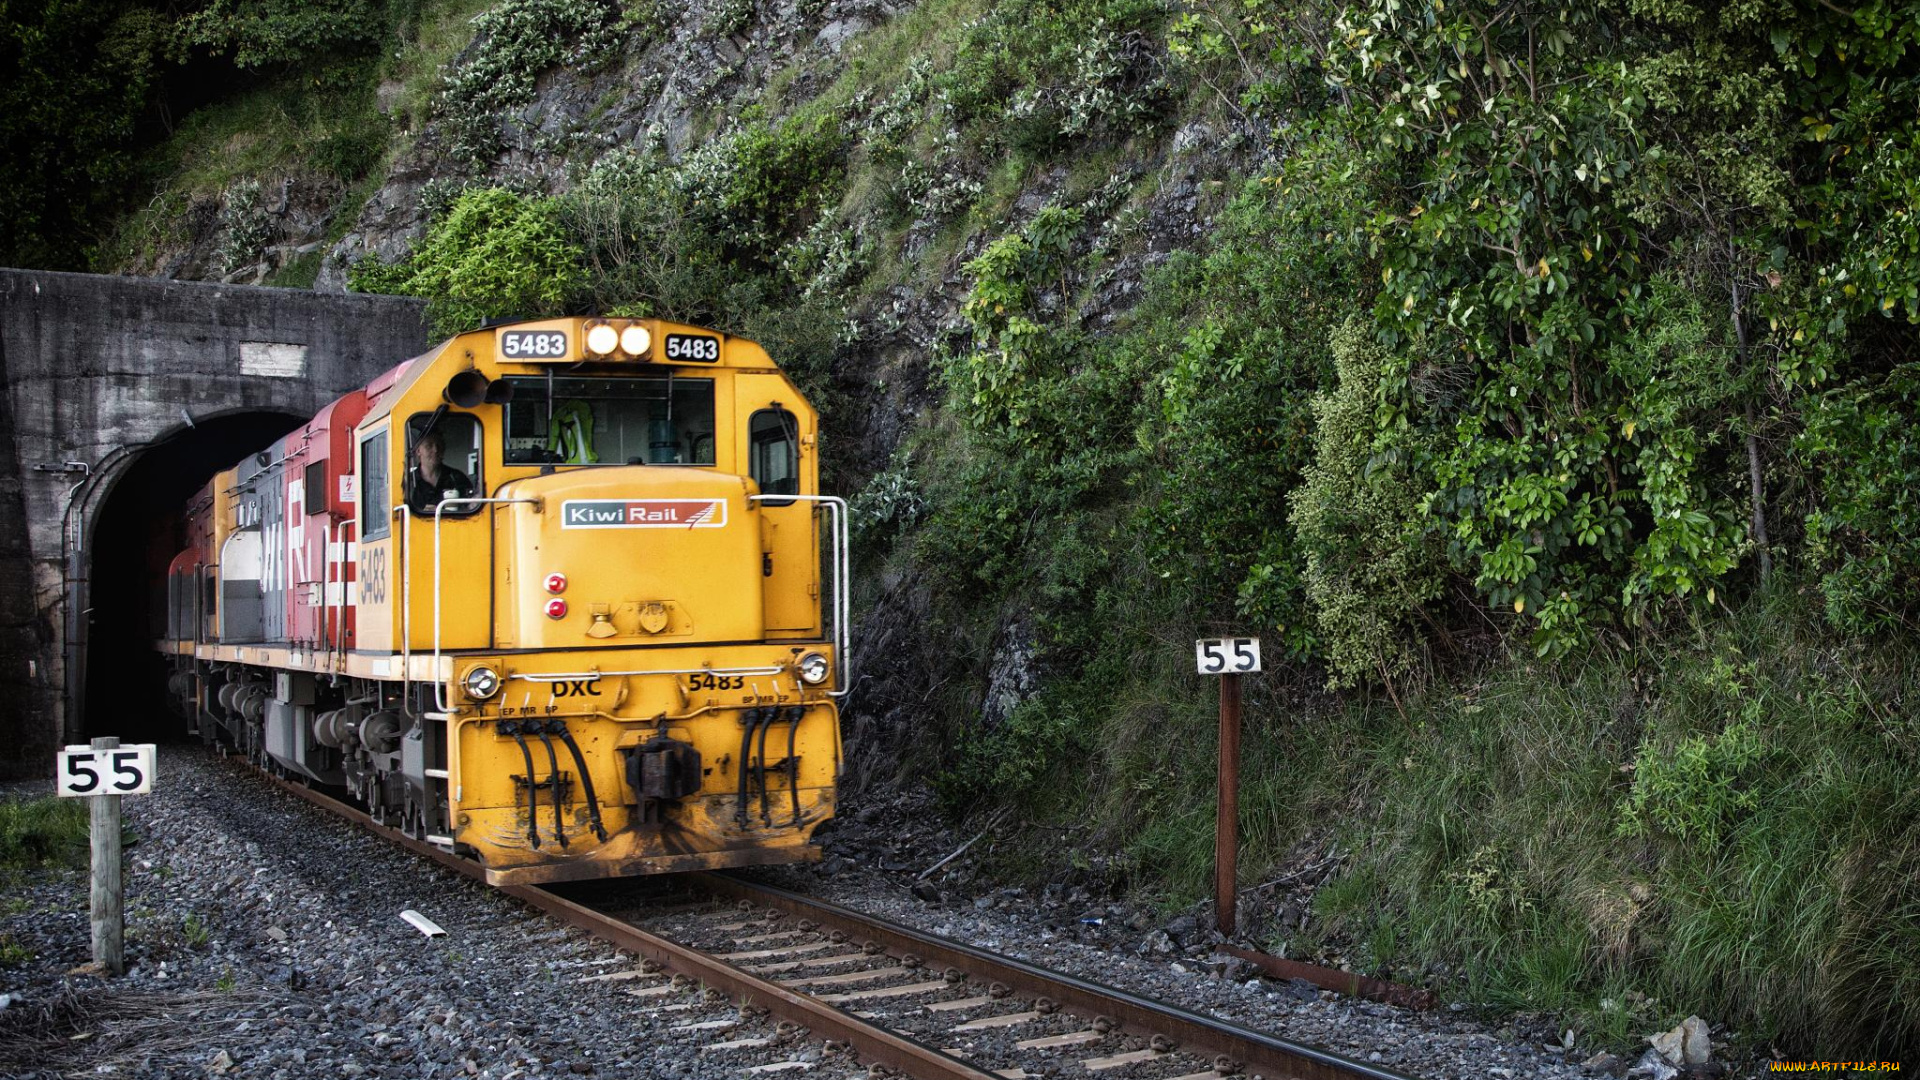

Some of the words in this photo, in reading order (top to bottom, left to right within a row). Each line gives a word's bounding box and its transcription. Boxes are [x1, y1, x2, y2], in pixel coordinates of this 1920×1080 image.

[505, 334, 565, 355] 5483
[667, 337, 718, 360] 5483
[361, 546, 386, 605] 5483
[552, 680, 602, 698] DXC
[689, 674, 744, 692] 5483
[503, 707, 515, 716] EP
